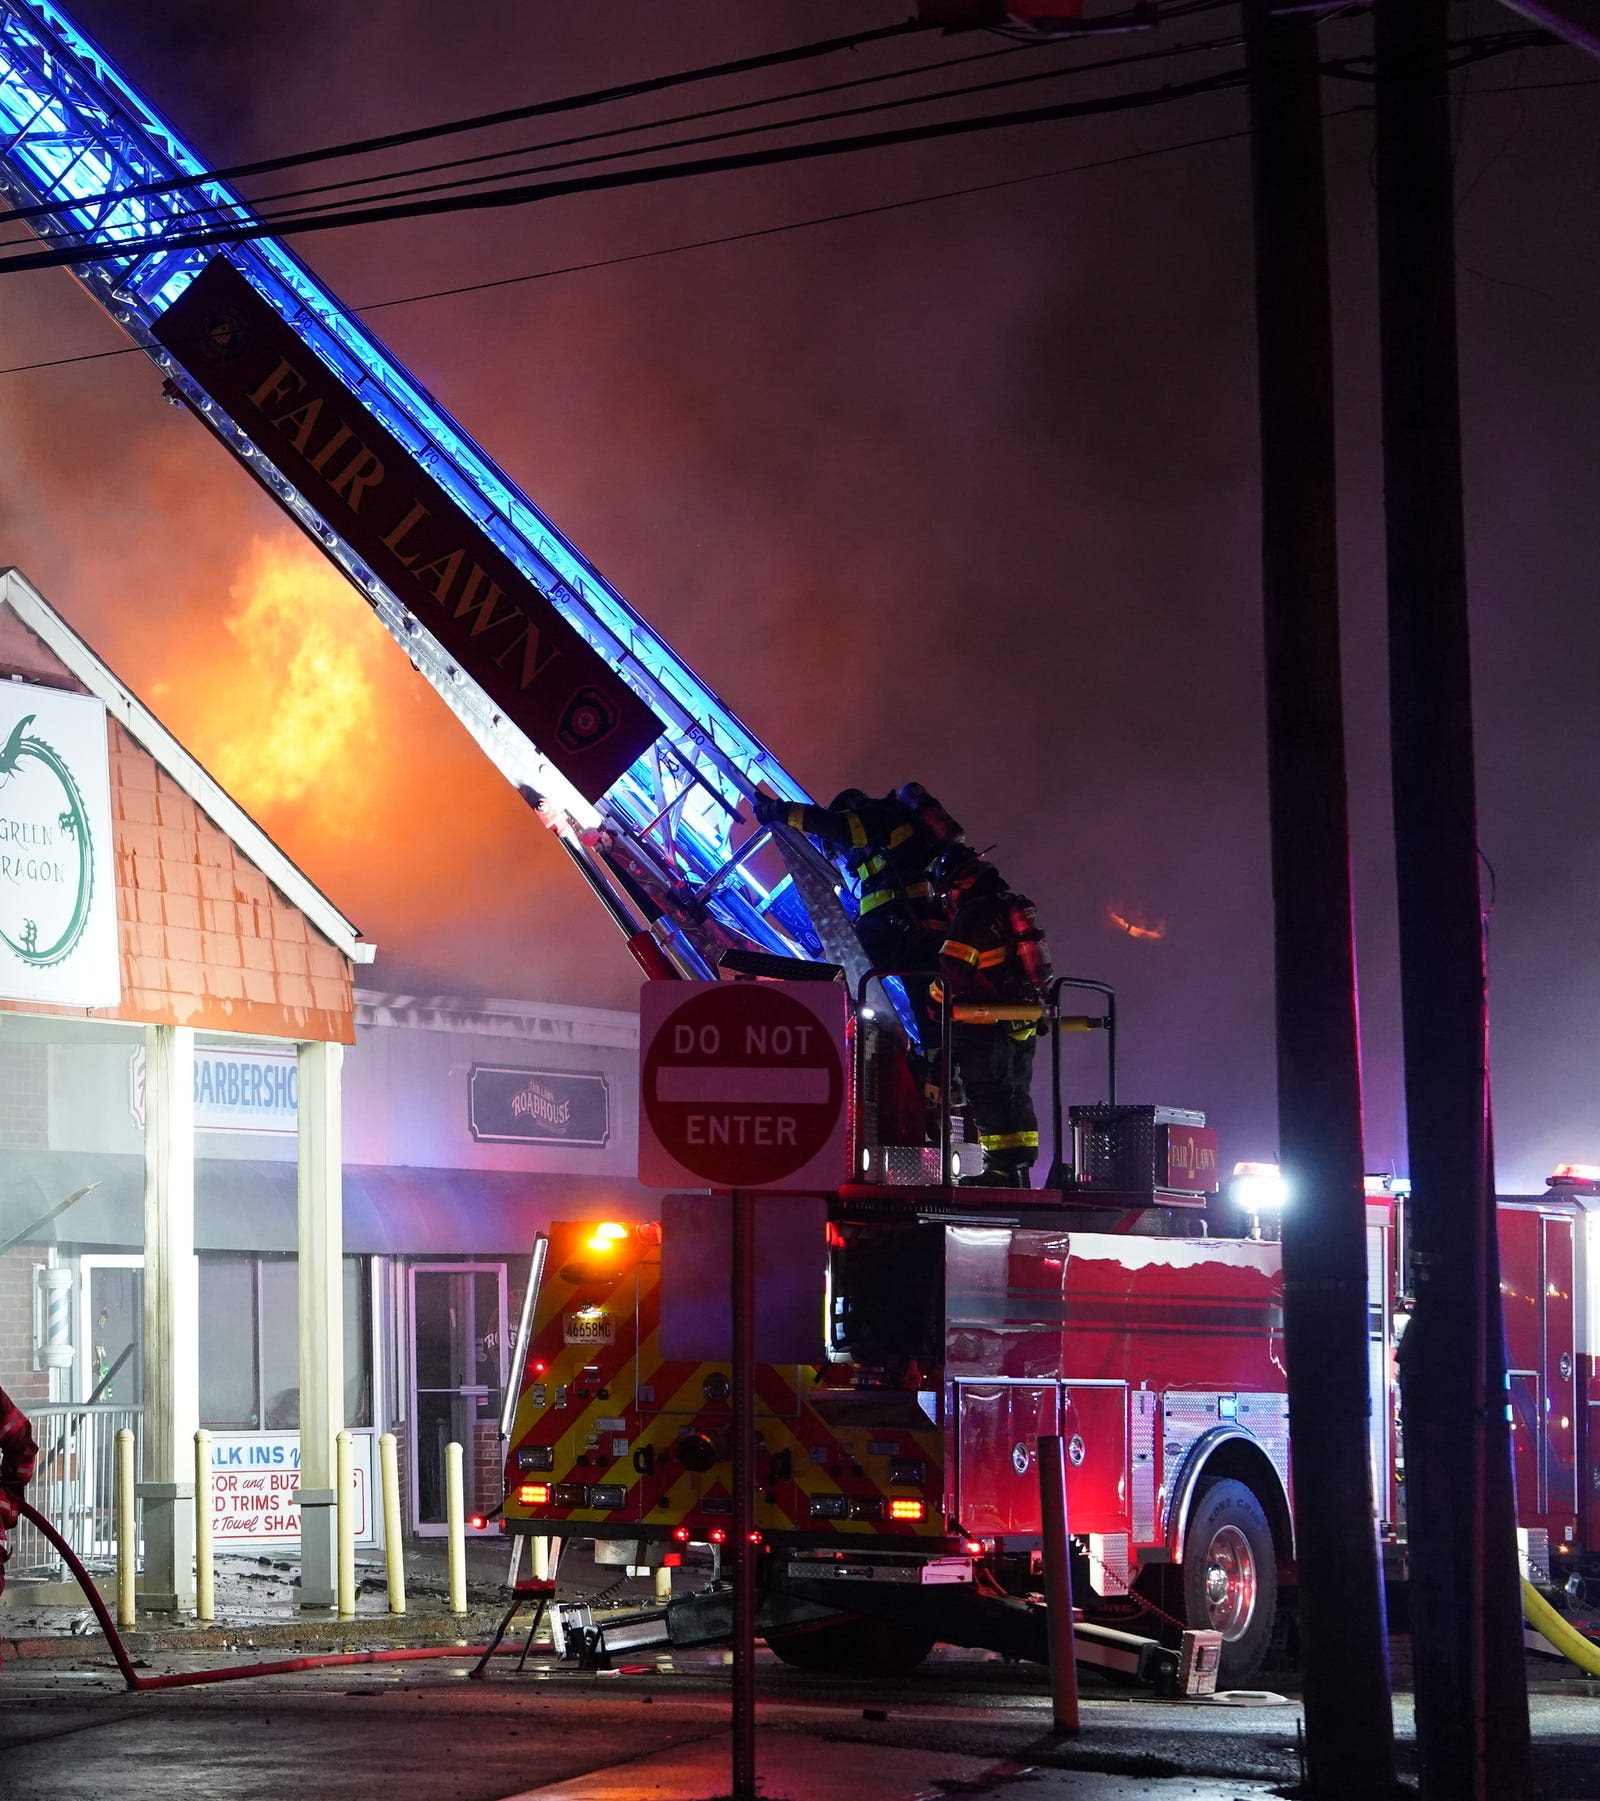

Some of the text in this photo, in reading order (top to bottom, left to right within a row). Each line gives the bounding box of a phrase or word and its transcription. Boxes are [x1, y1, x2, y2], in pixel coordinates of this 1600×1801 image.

[425, 446, 440, 465] 70
[247, 354, 565, 691] FAIR LAWN
[555, 587, 571, 604] 60
[688, 728, 706, 746] 50
[674, 1024, 813, 1056] DO NOT
[511, 1091, 570, 1124] ROADHOUSE
[686, 1115, 798, 1146] ENTER
[249, 1445, 285, 1465] INS
[212, 1475, 239, 1492] OR
[242, 1476, 266, 1491] and
[230, 1494, 280, 1512] TRIMS
[221, 1514, 259, 1533] Towel
